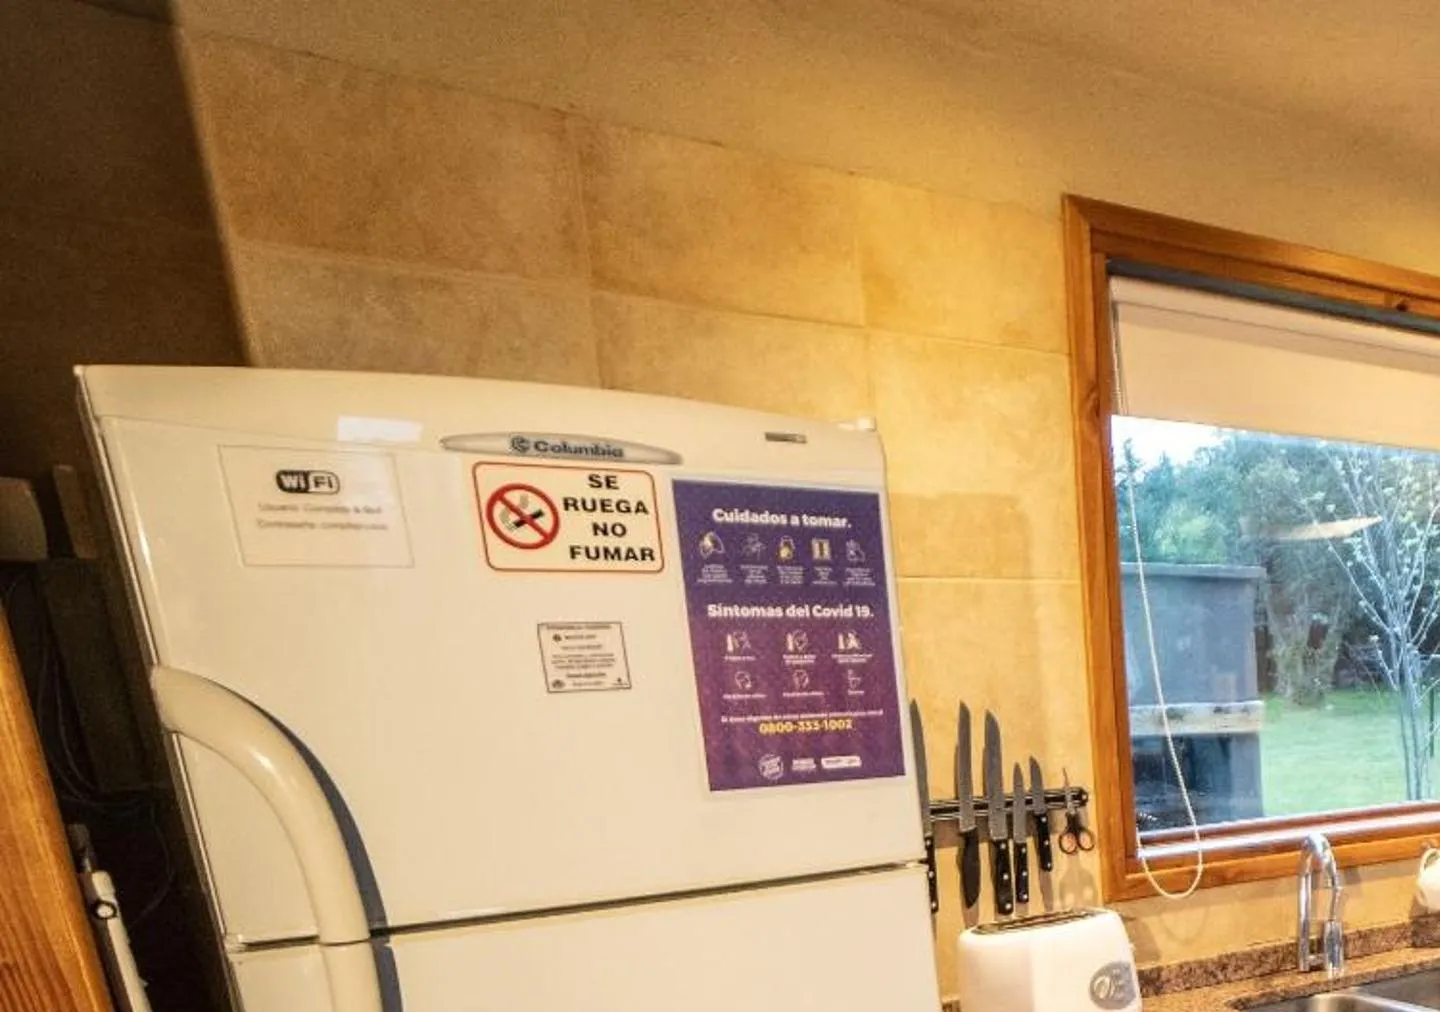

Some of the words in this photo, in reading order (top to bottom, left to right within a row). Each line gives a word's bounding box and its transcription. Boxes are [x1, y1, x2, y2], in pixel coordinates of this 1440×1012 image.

[533, 439, 624, 458] Columbia
[587, 473, 620, 490] SE
[562, 496, 650, 514] RUEGA
[711, 508, 788, 526] Cuidados
[790, 514, 800, 526] a
[802, 513, 852, 529] tomar.
[592, 522, 628, 538] NO
[568, 545, 656, 562] FUMAR
[785, 603, 811, 619] del
[811, 604, 853, 619] Covid
